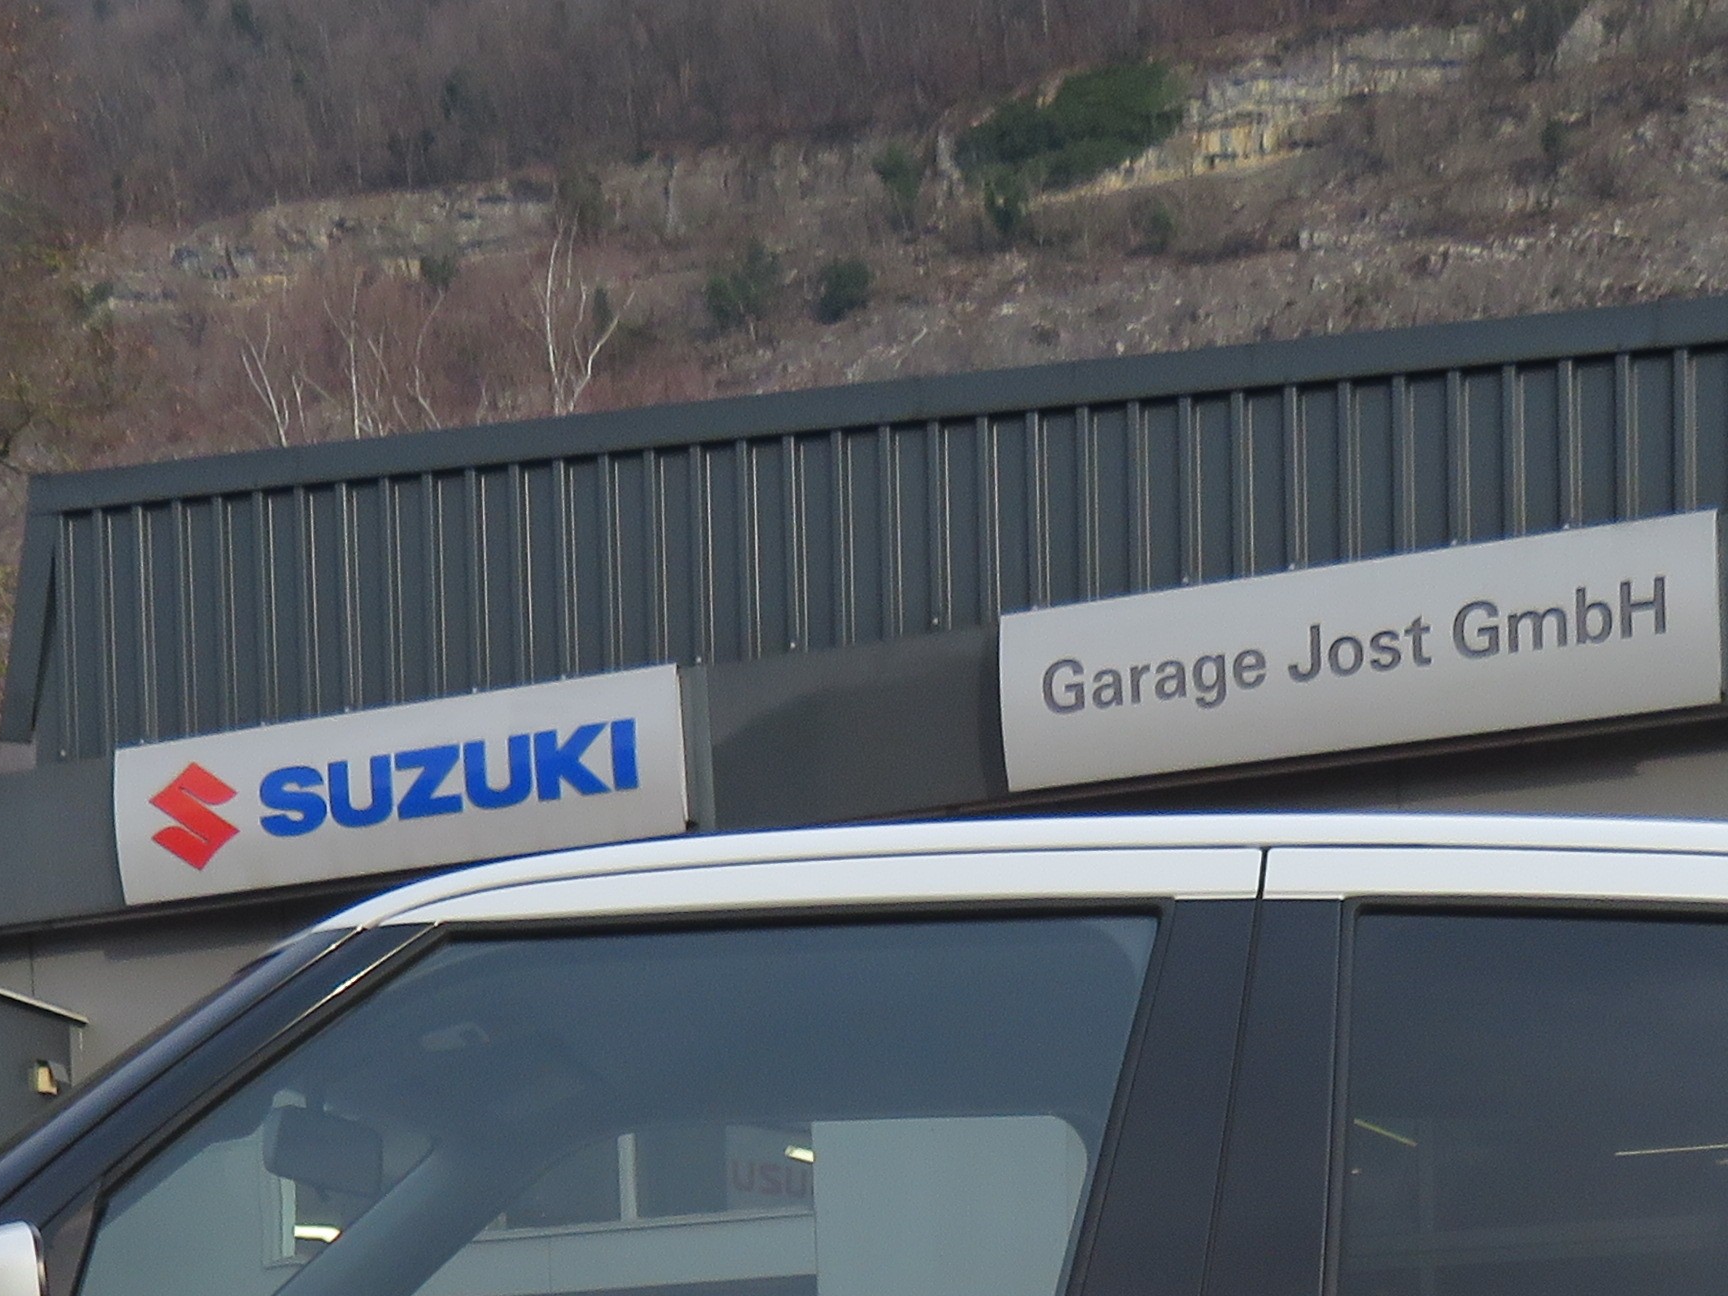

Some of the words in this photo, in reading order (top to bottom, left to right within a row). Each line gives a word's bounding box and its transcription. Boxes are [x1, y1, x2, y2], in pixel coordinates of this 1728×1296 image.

[1041, 647, 1266, 715] Garage
[1287, 615, 1432, 684] Jost
[1452, 575, 1668, 661] GmbH
[259, 717, 640, 837] SUZUKI
